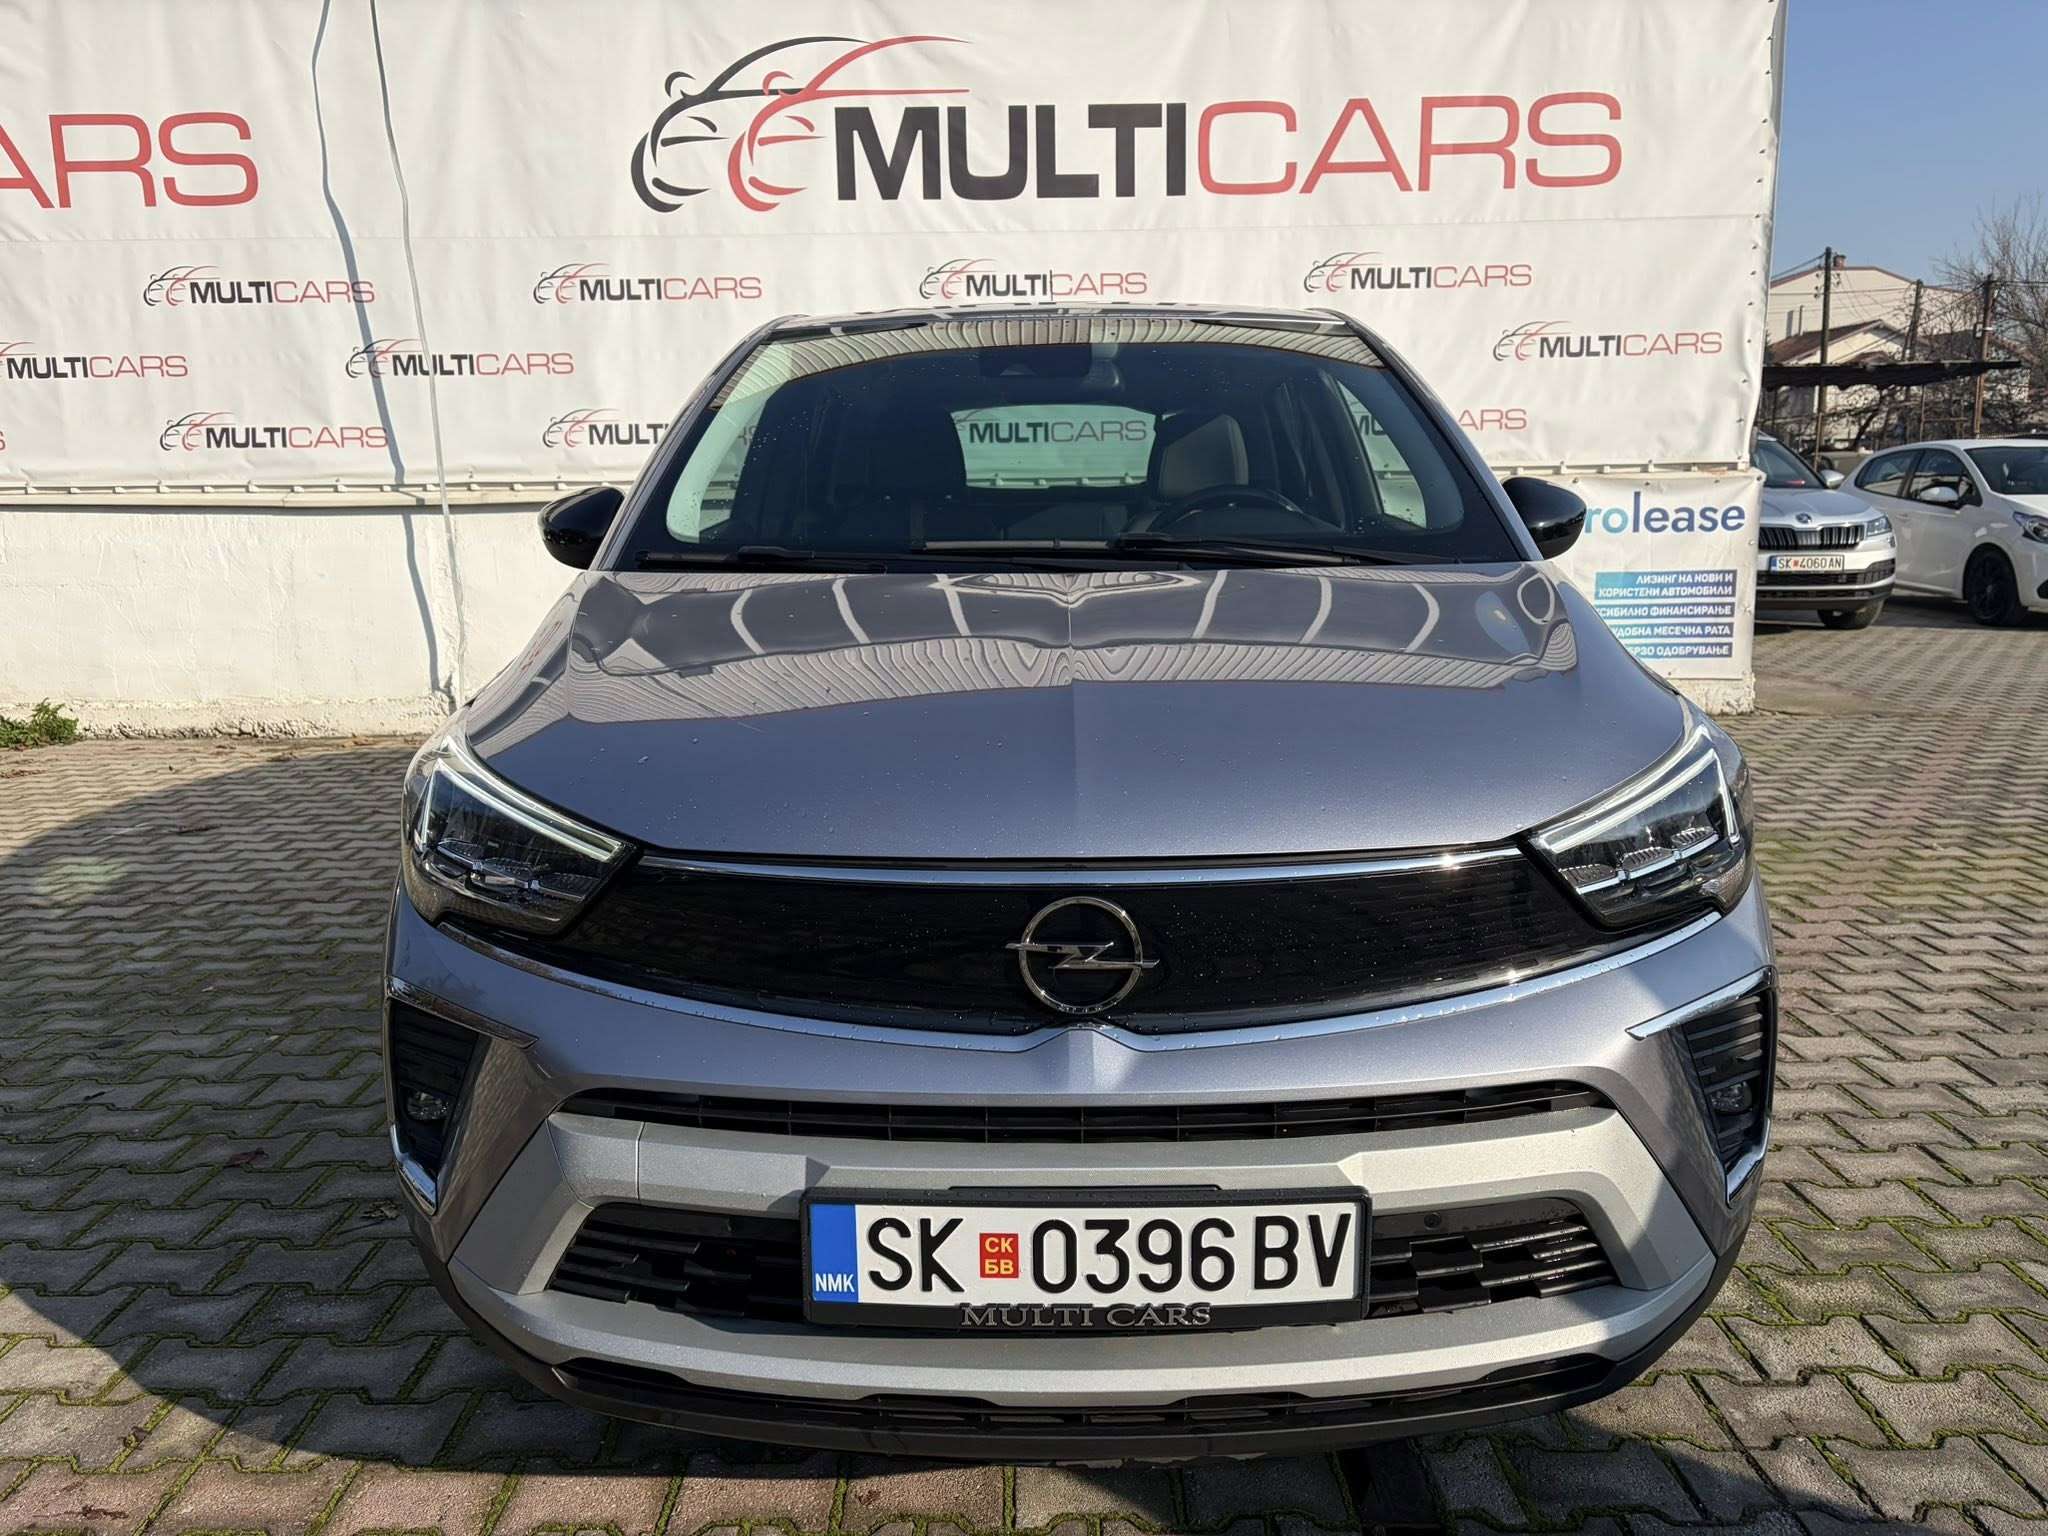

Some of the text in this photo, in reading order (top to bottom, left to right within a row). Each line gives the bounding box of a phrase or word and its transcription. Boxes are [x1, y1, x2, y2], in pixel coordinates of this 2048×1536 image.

[834, 92, 1622, 200] MULTICARS
[965, 272, 1147, 297] MULTICARS
[1350, 264, 1532, 289] MULTICARS
[190, 280, 375, 303] MULTICARS
[579, 277, 762, 301] MULTICARS
[1539, 332, 1722, 358] MULTICARS
[7, 355, 188, 379] MULTICARS
[392, 352, 574, 376] MULTICARS
[205, 426, 388, 449] MULTICARS
[588, 423, 669, 445] MULT
[969, 420, 1146, 443] MULTICARS
[1778, 558, 1792, 569] SK
[1799, 557, 1827, 569] 4060
[1828, 557, 1842, 569] AN
[1635, 572, 1734, 585] ЛИЗИНГ НА НОВИ И
[1599, 585, 1733, 598] КОРИСТЕНИ АВТОМОБИЛИ
[1650, 605, 1732, 616] ФИНАНСИРАЊЕ
[1653, 625, 1703, 636] МЕСЕЧНА
[1705, 625, 1731, 635] РАТА
[1656, 645, 1729, 657] ОДОБРУВАЊЕ
[868, 1213, 1352, 1294] SK 0396 BV
[815, 1273, 855, 1293] NMK
[960, 1304, 1211, 1327] MULTI CARS
